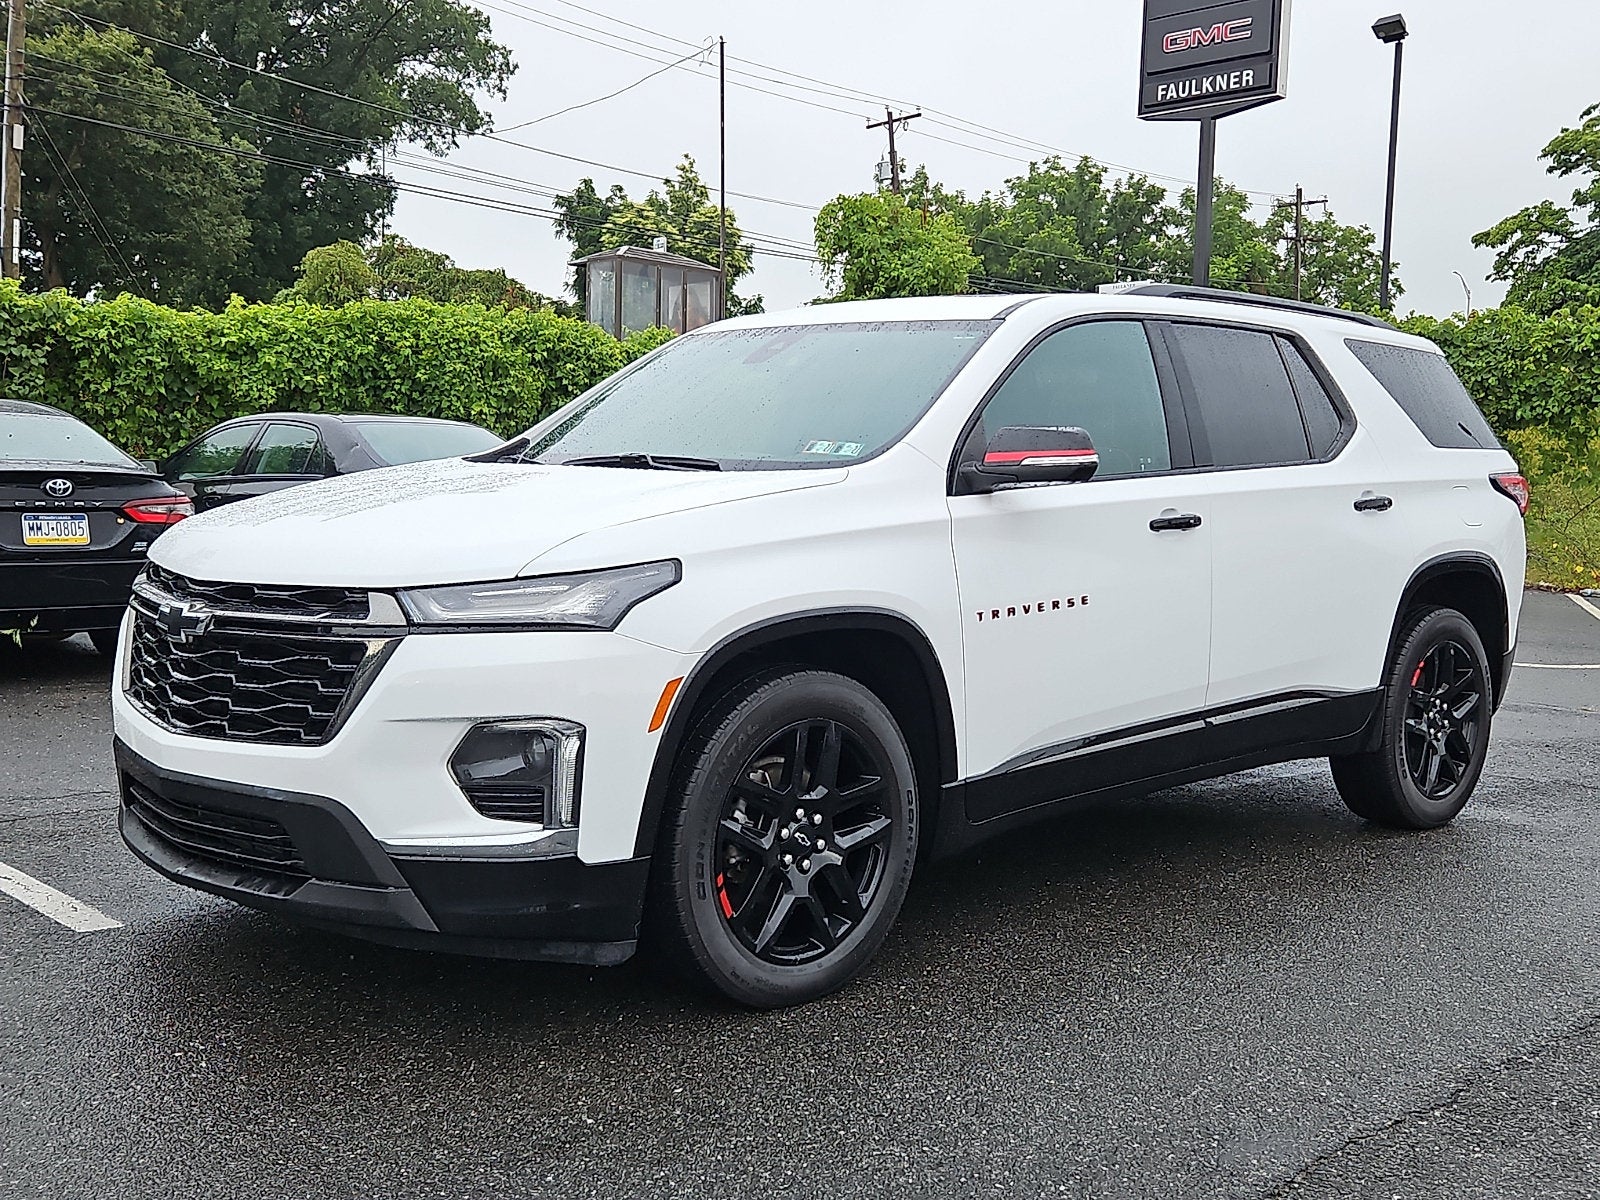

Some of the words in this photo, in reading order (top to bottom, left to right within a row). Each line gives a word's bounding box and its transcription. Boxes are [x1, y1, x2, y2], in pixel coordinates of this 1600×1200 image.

[1163, 17, 1252, 53] GMC
[1157, 69, 1254, 101] FAULKNER
[976, 595, 1089, 622] TRAVERSE
